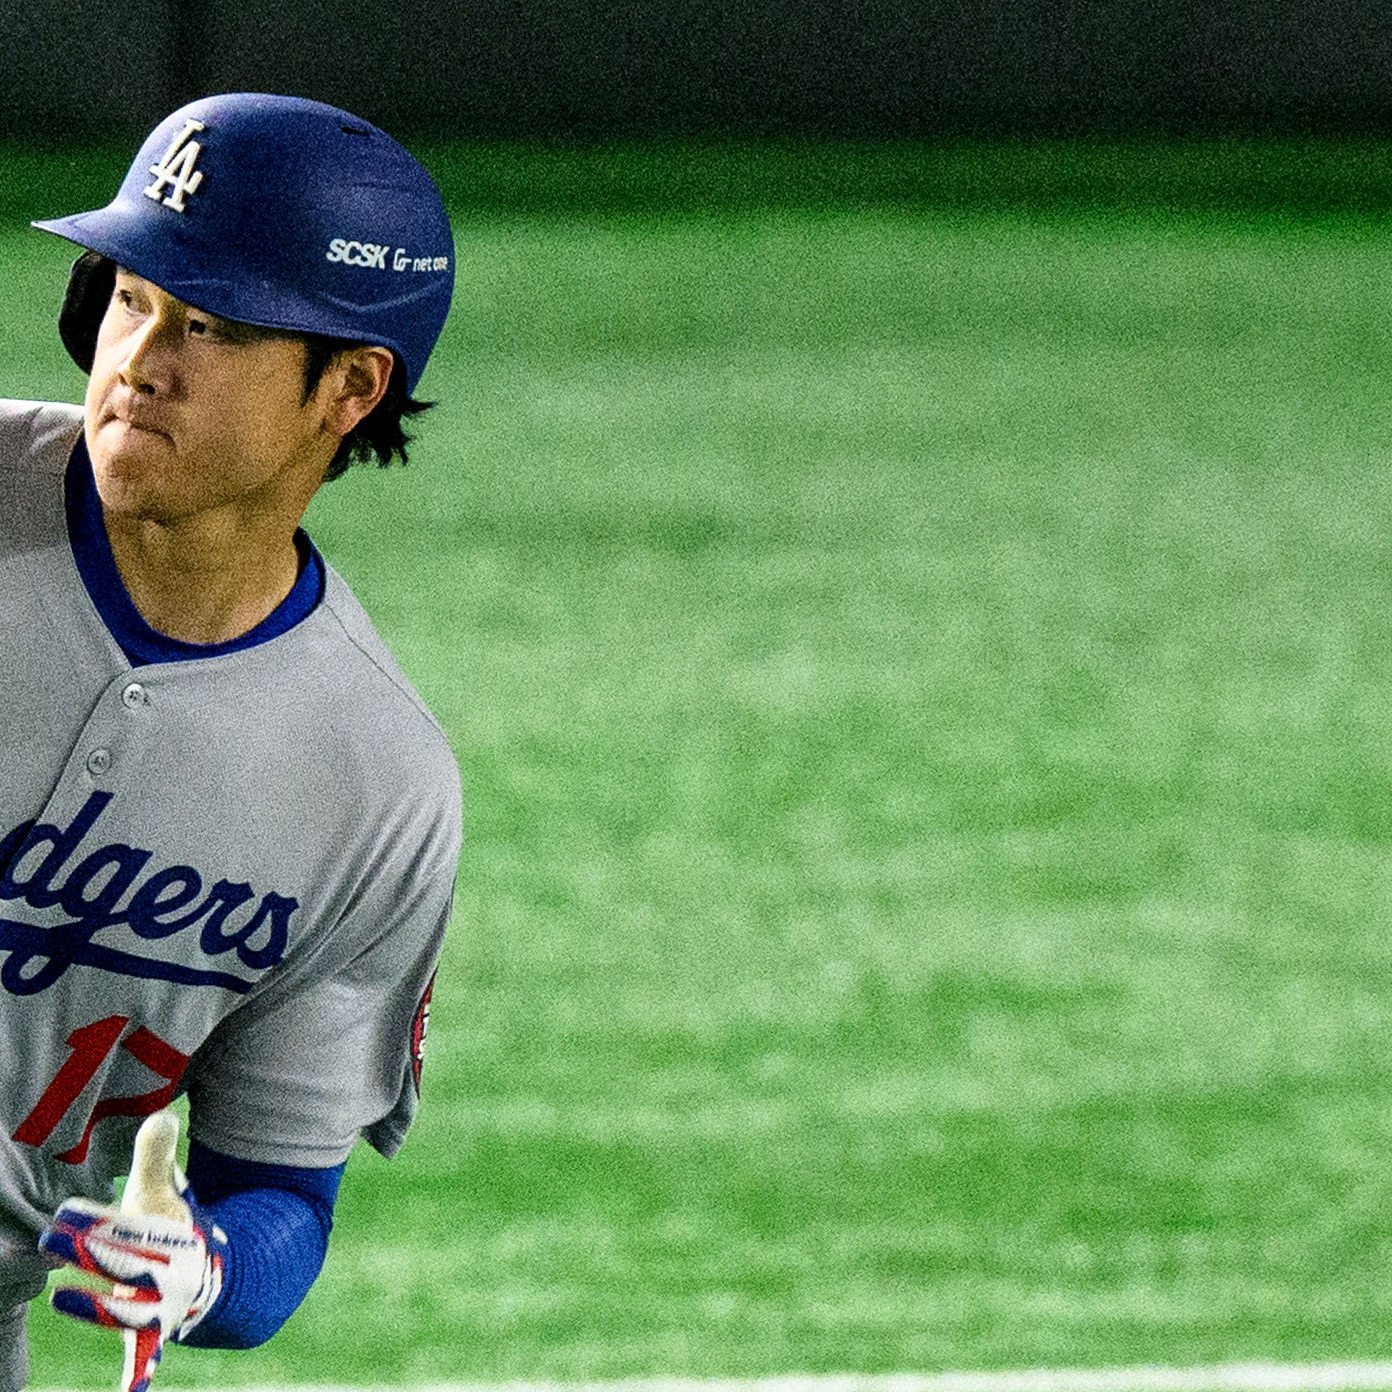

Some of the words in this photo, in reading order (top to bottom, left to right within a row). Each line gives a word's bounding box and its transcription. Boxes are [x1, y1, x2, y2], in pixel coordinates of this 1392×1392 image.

[143, 119, 205, 213] LA
[326, 238, 390, 270] SCSK
[11, 1015, 192, 1165] 17
